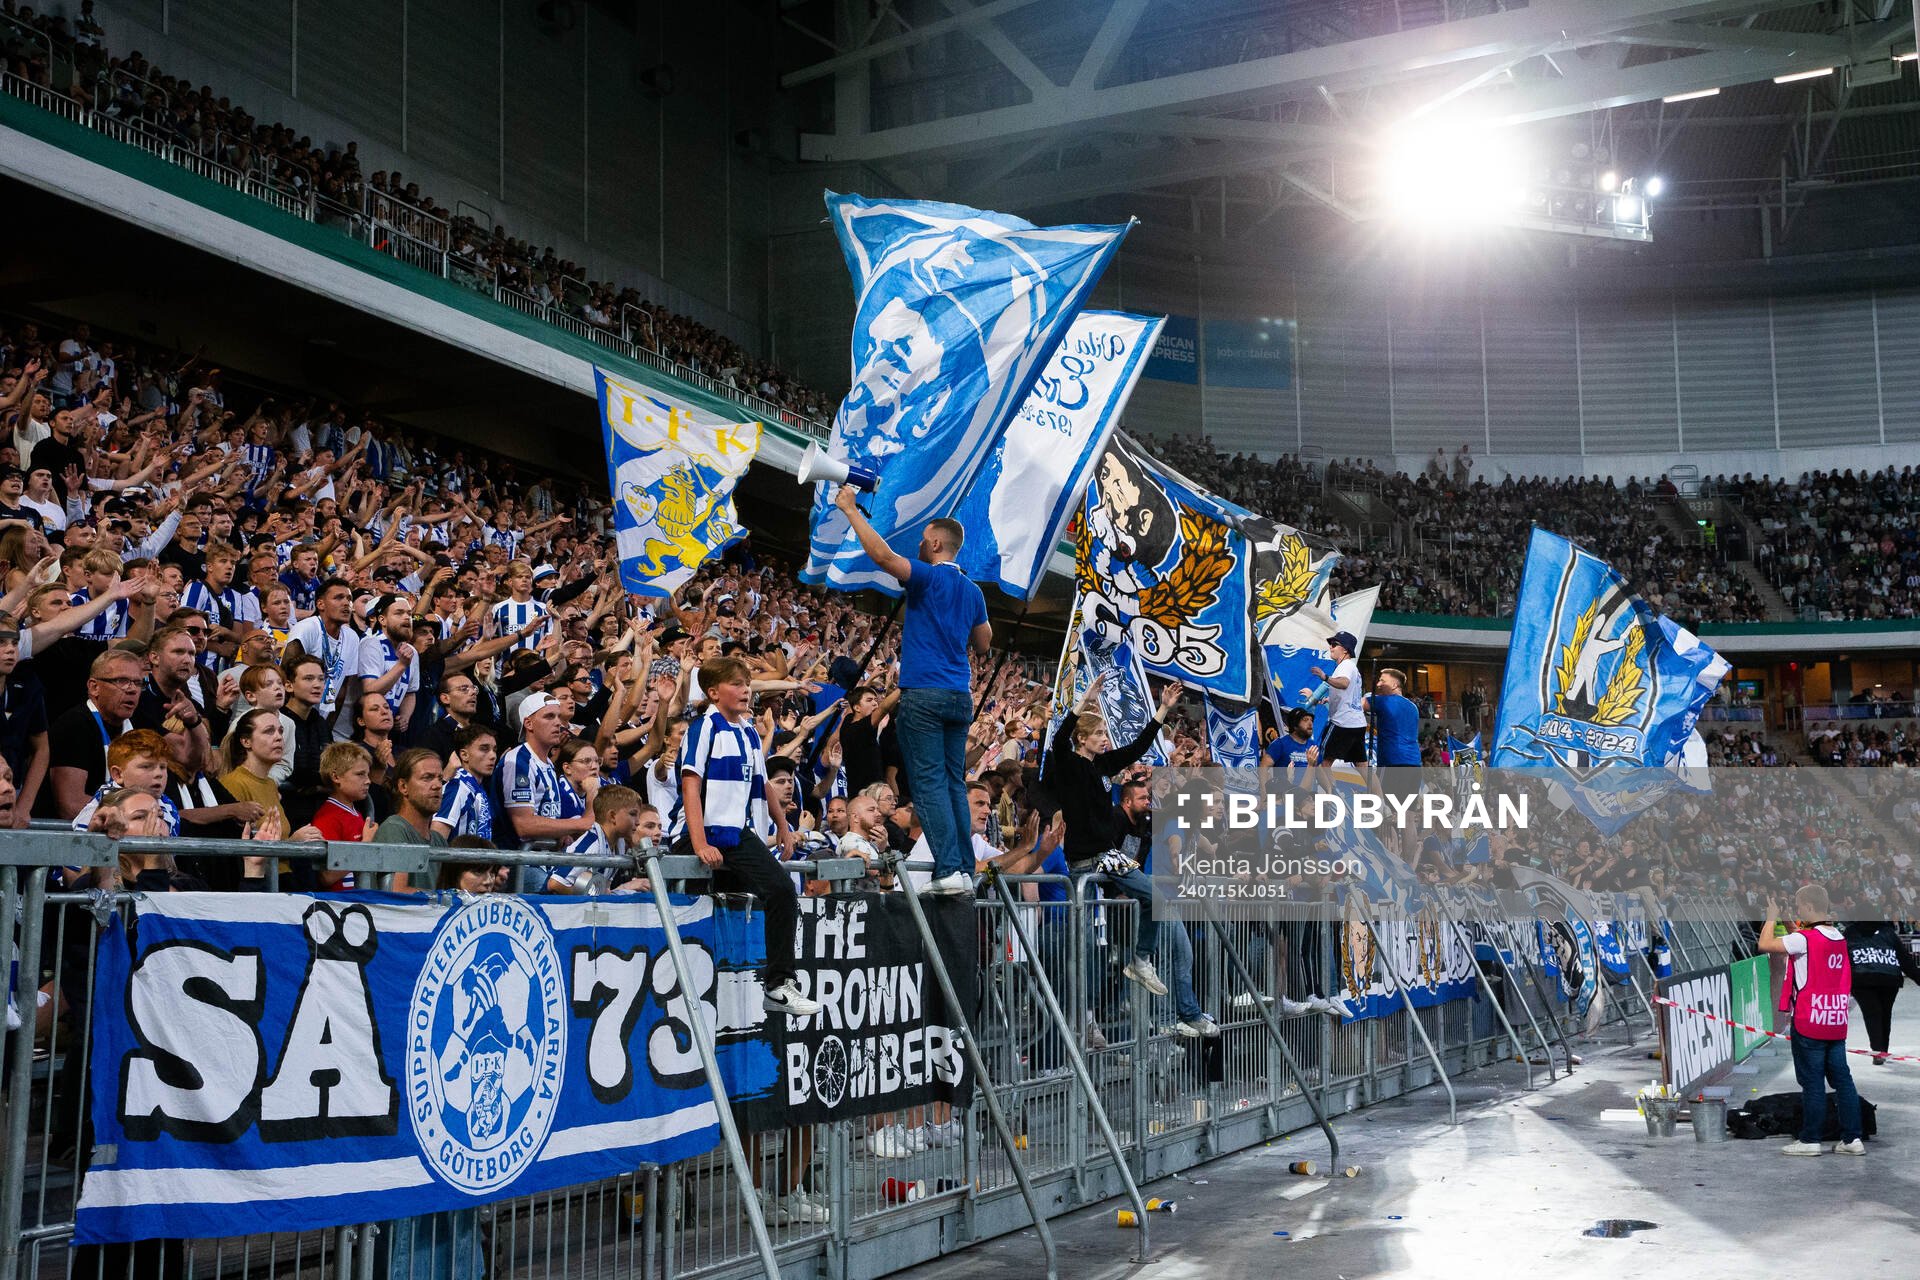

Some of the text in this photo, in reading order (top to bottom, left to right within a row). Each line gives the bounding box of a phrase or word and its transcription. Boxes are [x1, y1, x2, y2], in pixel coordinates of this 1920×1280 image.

[795, 897, 868, 960] THE
[1828, 953, 1844, 969] 02
[118, 904, 397, 1143] SÄ
[570, 940, 716, 1100] 73
[1668, 972, 1733, 1094] ARBESKO
[439, 1125, 534, 1182] GÖTEBORG
